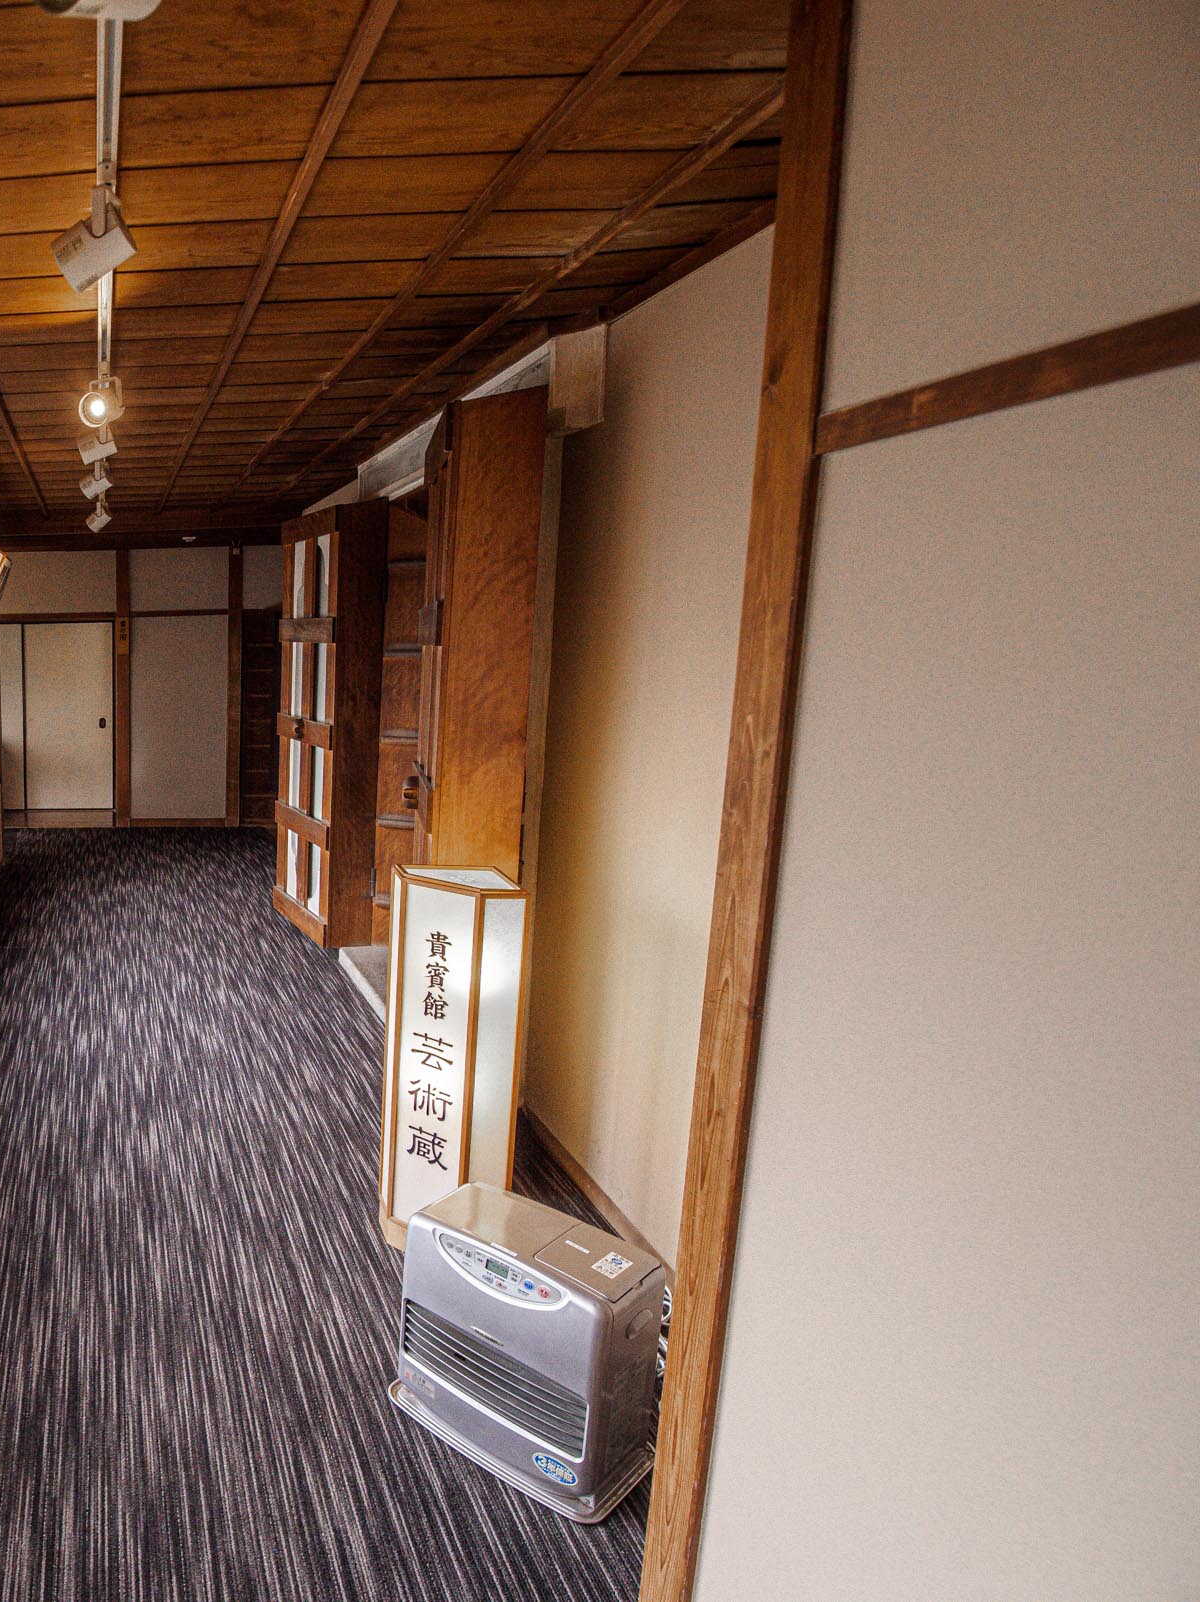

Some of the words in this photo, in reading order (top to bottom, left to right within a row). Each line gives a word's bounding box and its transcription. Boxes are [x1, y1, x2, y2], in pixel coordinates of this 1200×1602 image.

[422, 930, 453, 1021] 貴賓館
[407, 1032, 454, 1171] 芸術蔵
